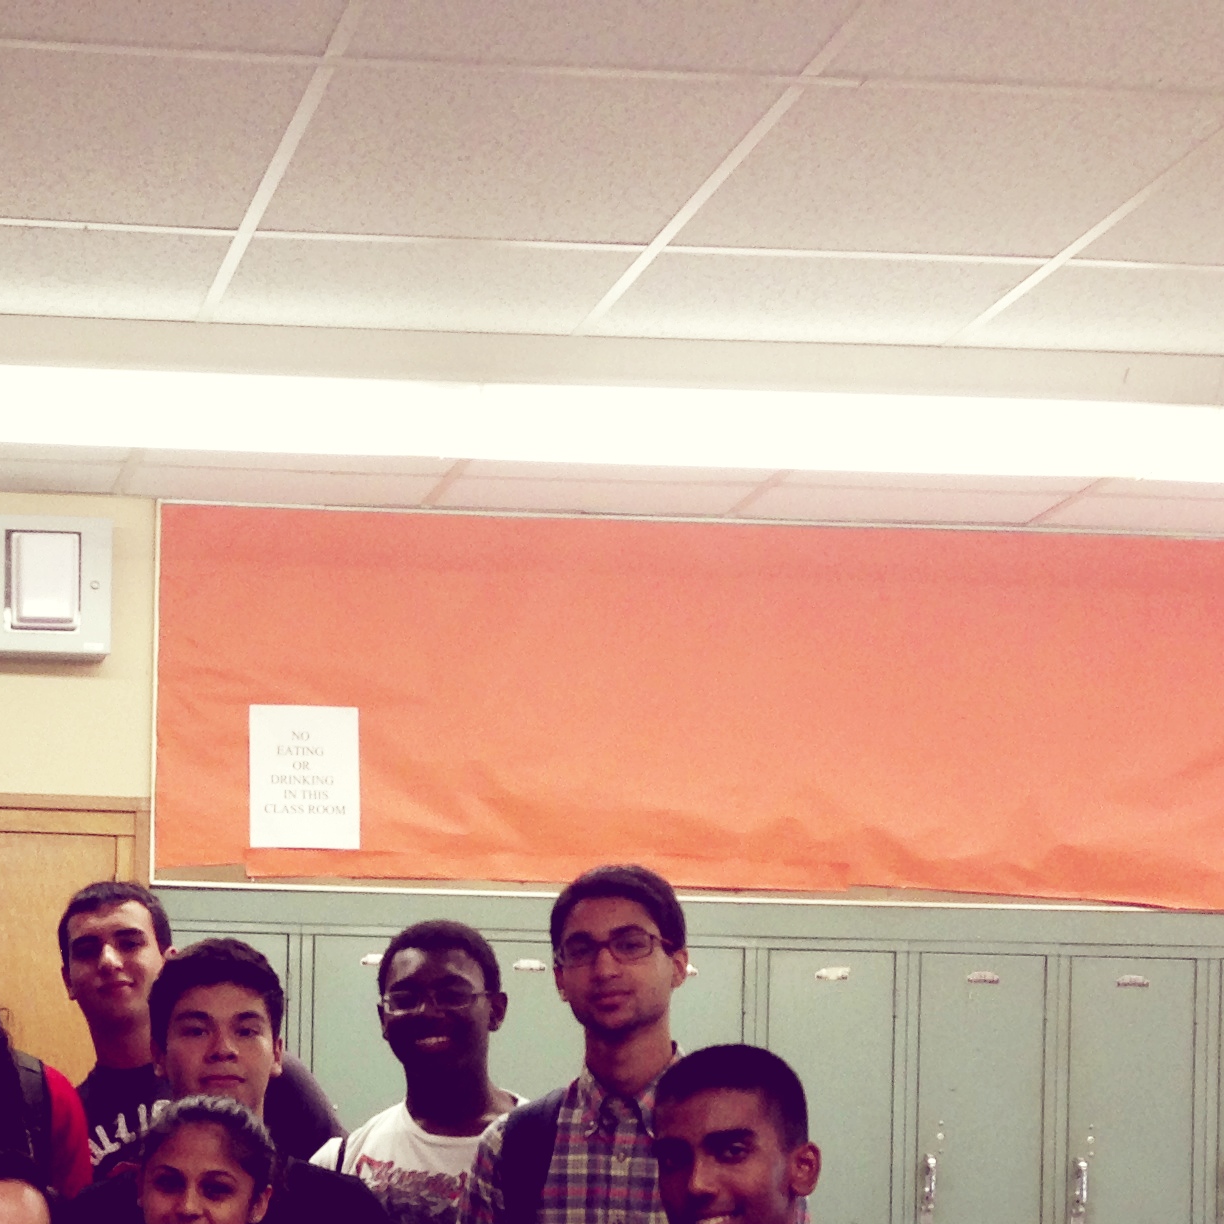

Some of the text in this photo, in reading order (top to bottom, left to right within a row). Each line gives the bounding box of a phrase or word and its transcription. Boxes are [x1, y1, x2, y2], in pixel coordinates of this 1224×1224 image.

[291, 730, 310, 742] NO
[276, 745, 324, 757] EATING
[292, 760, 310, 771] OR
[270, 774, 334, 786] DRINKING
[284, 789, 329, 801] IN THIS
[264, 803, 346, 816] CLASS ROOM
